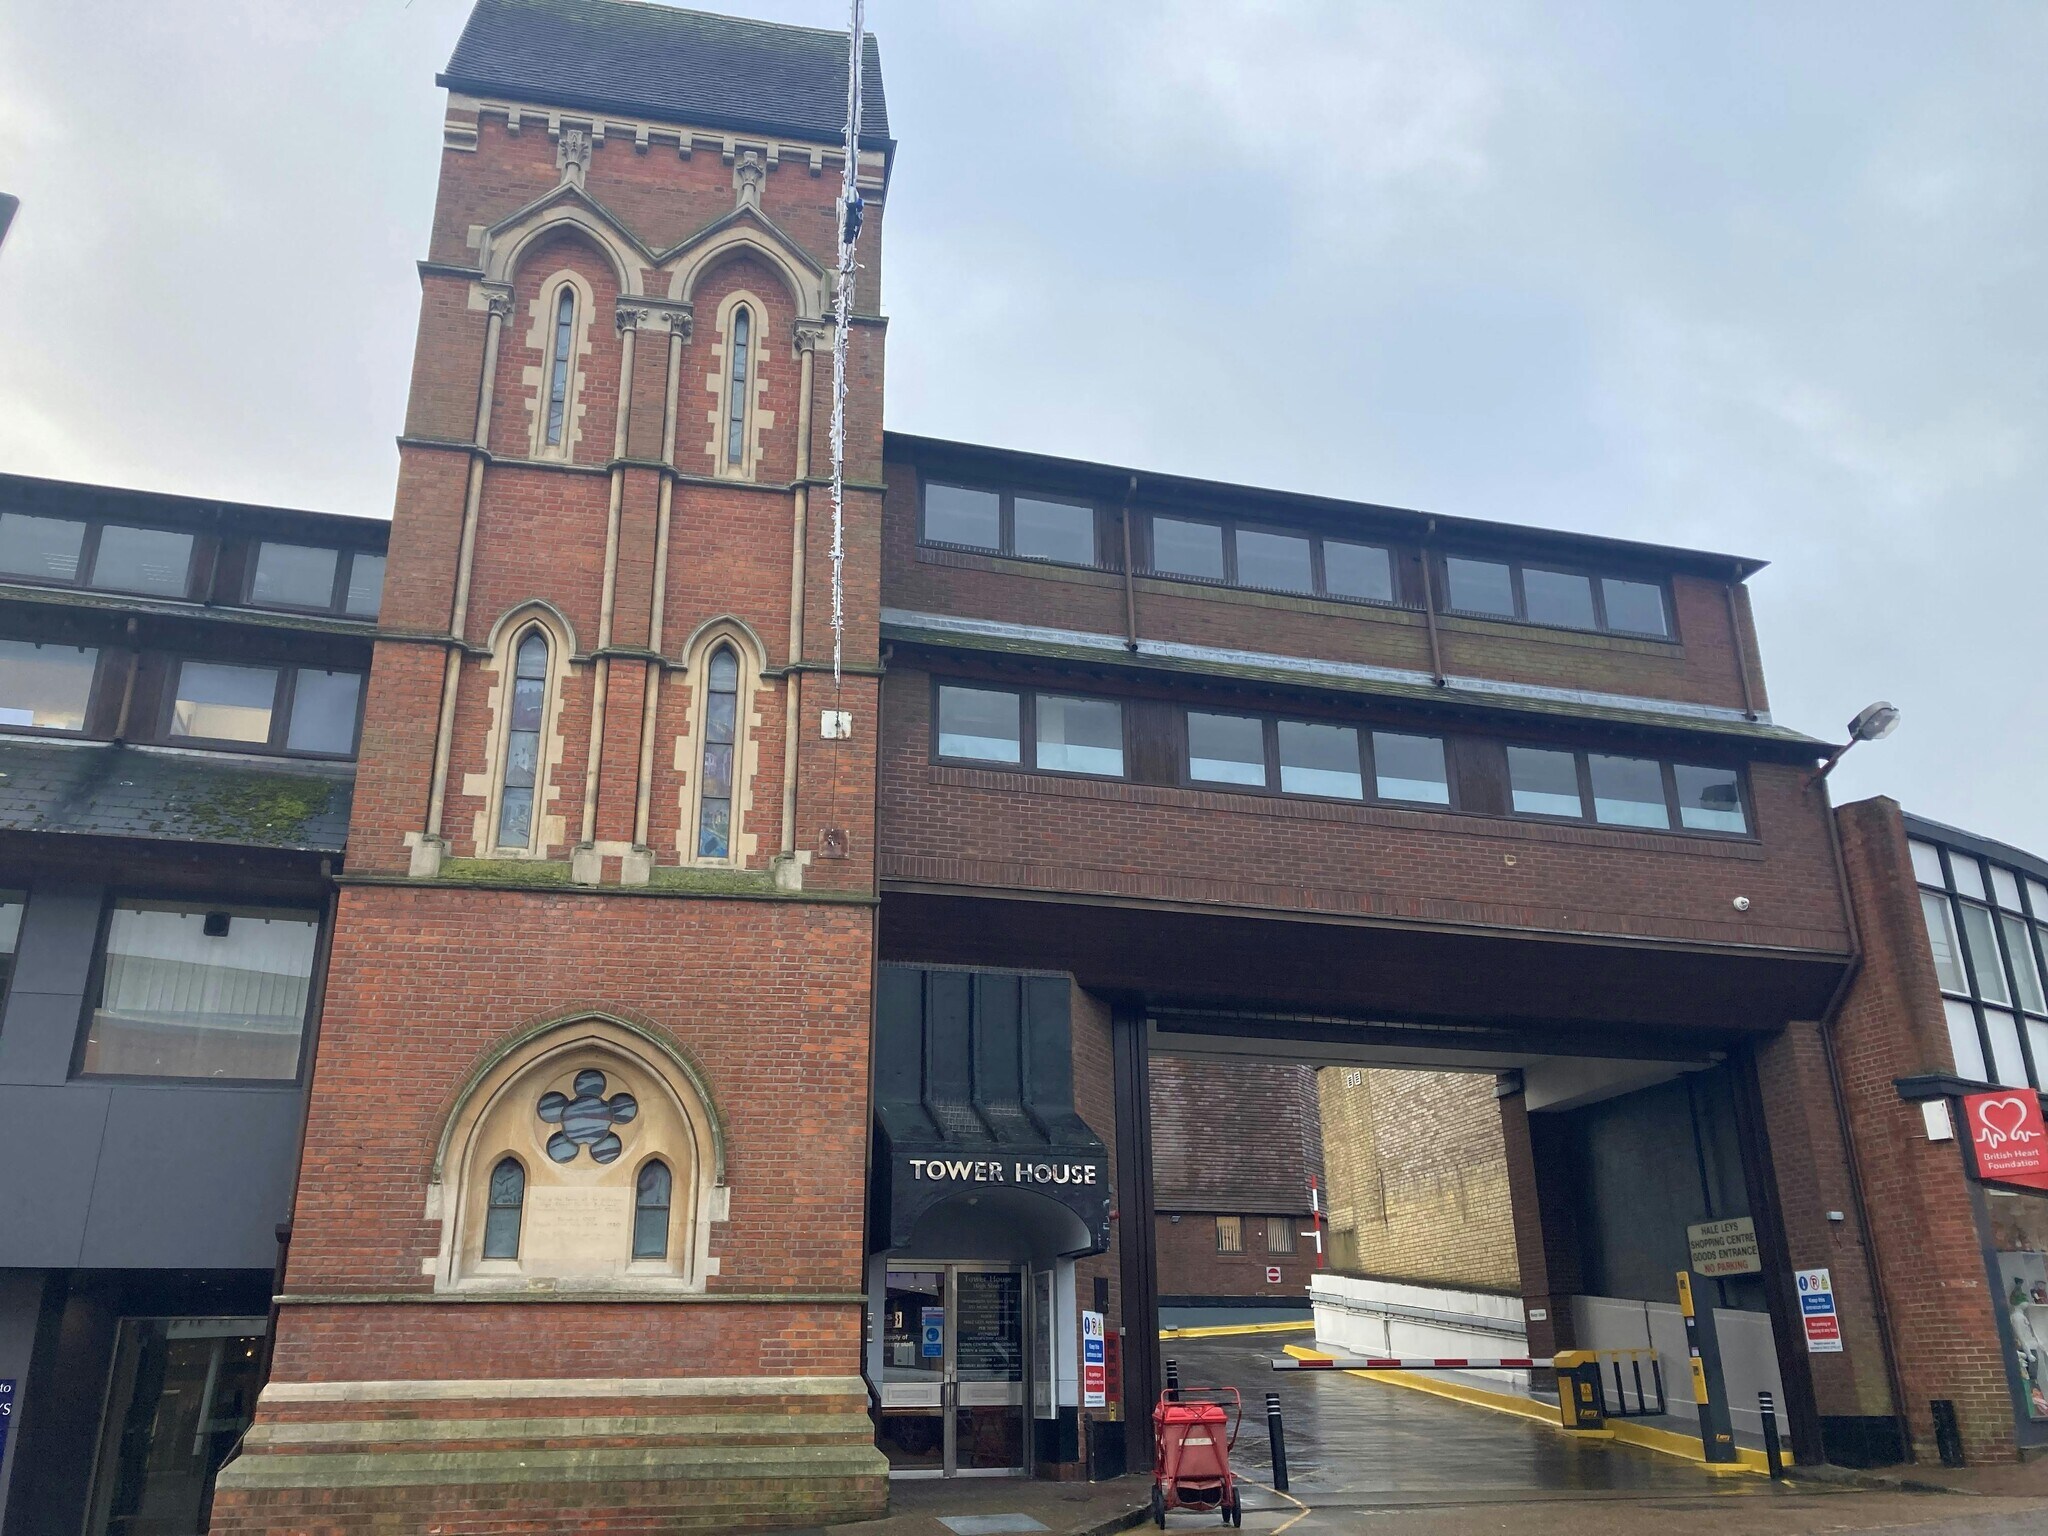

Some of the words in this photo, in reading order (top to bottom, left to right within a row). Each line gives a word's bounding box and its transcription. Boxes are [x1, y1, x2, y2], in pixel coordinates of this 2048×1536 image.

[1983, 1151, 2013, 1160] British
[2014, 1149, 2040, 1157] Heart
[1988, 1160, 2040, 1170] Foundation
[909, 1159, 1004, 1183] TOWER
[1015, 1162, 1097, 1185] HOUSE
[1701, 1224, 1719, 1235] HALE
[1721, 1222, 1739, 1233] LEYS
[1690, 1236, 1725, 1249] SHOPPING
[1726, 1232, 1756, 1245] CENTRE
[1692, 1250, 1717, 1262] GOODS
[1718, 1245, 1758, 1259] ENTRANCE
[1703, 1263, 1716, 1273] NO
[1717, 1260, 1749, 1271] PARKING
